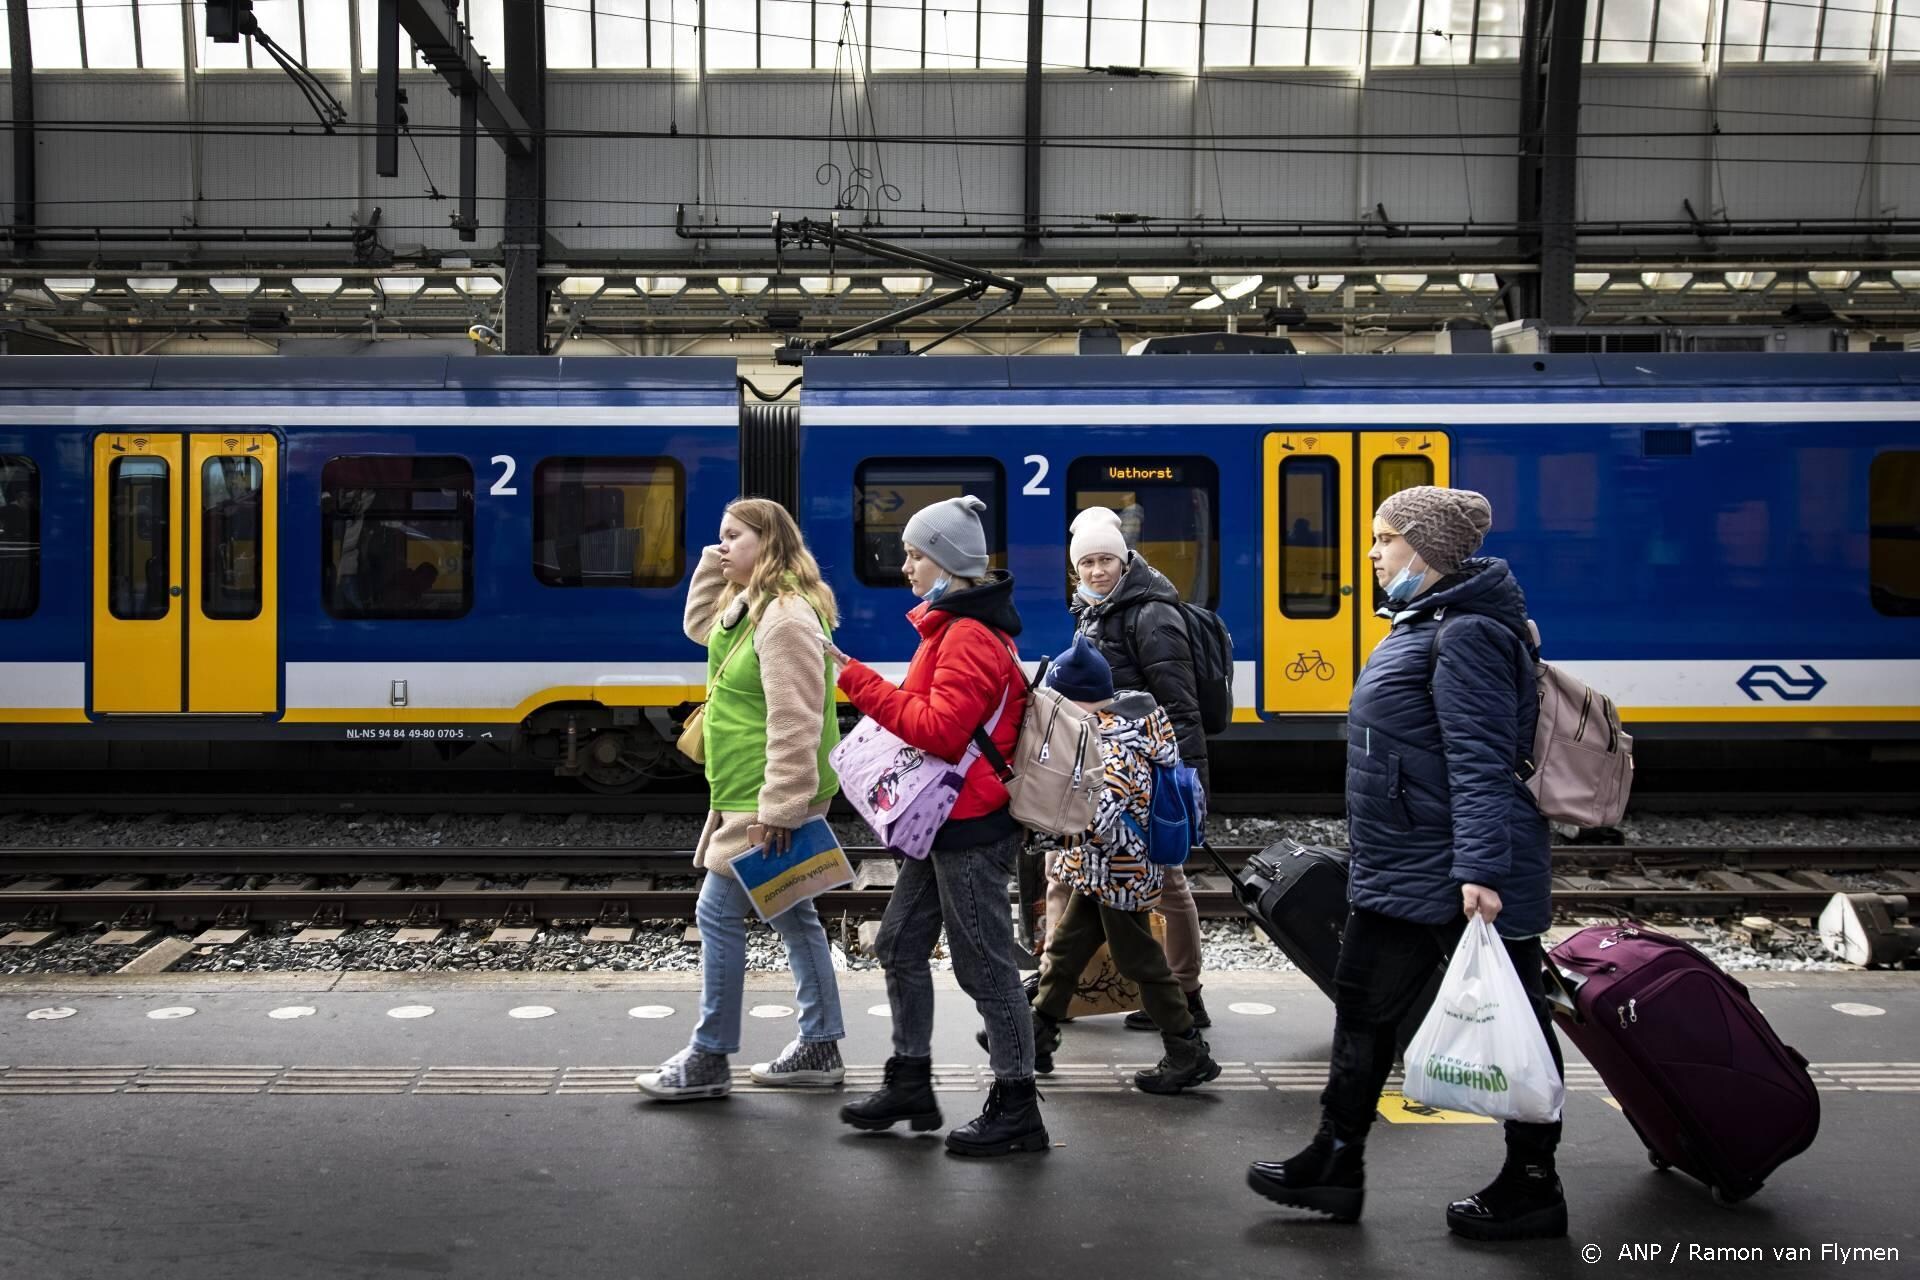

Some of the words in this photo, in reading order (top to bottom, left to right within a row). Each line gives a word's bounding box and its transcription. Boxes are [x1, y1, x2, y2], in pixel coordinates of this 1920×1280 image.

[490, 454, 518, 496] 2
[1022, 454, 1051, 496] 2
[1109, 466, 1173, 479] Vathorst
[346, 729, 376, 739] NL-NS
[378, 729, 391, 738] 94
[393, 729, 406, 738] 84
[408, 729, 435, 738] 49-80
[437, 729, 464, 738] 070-5
